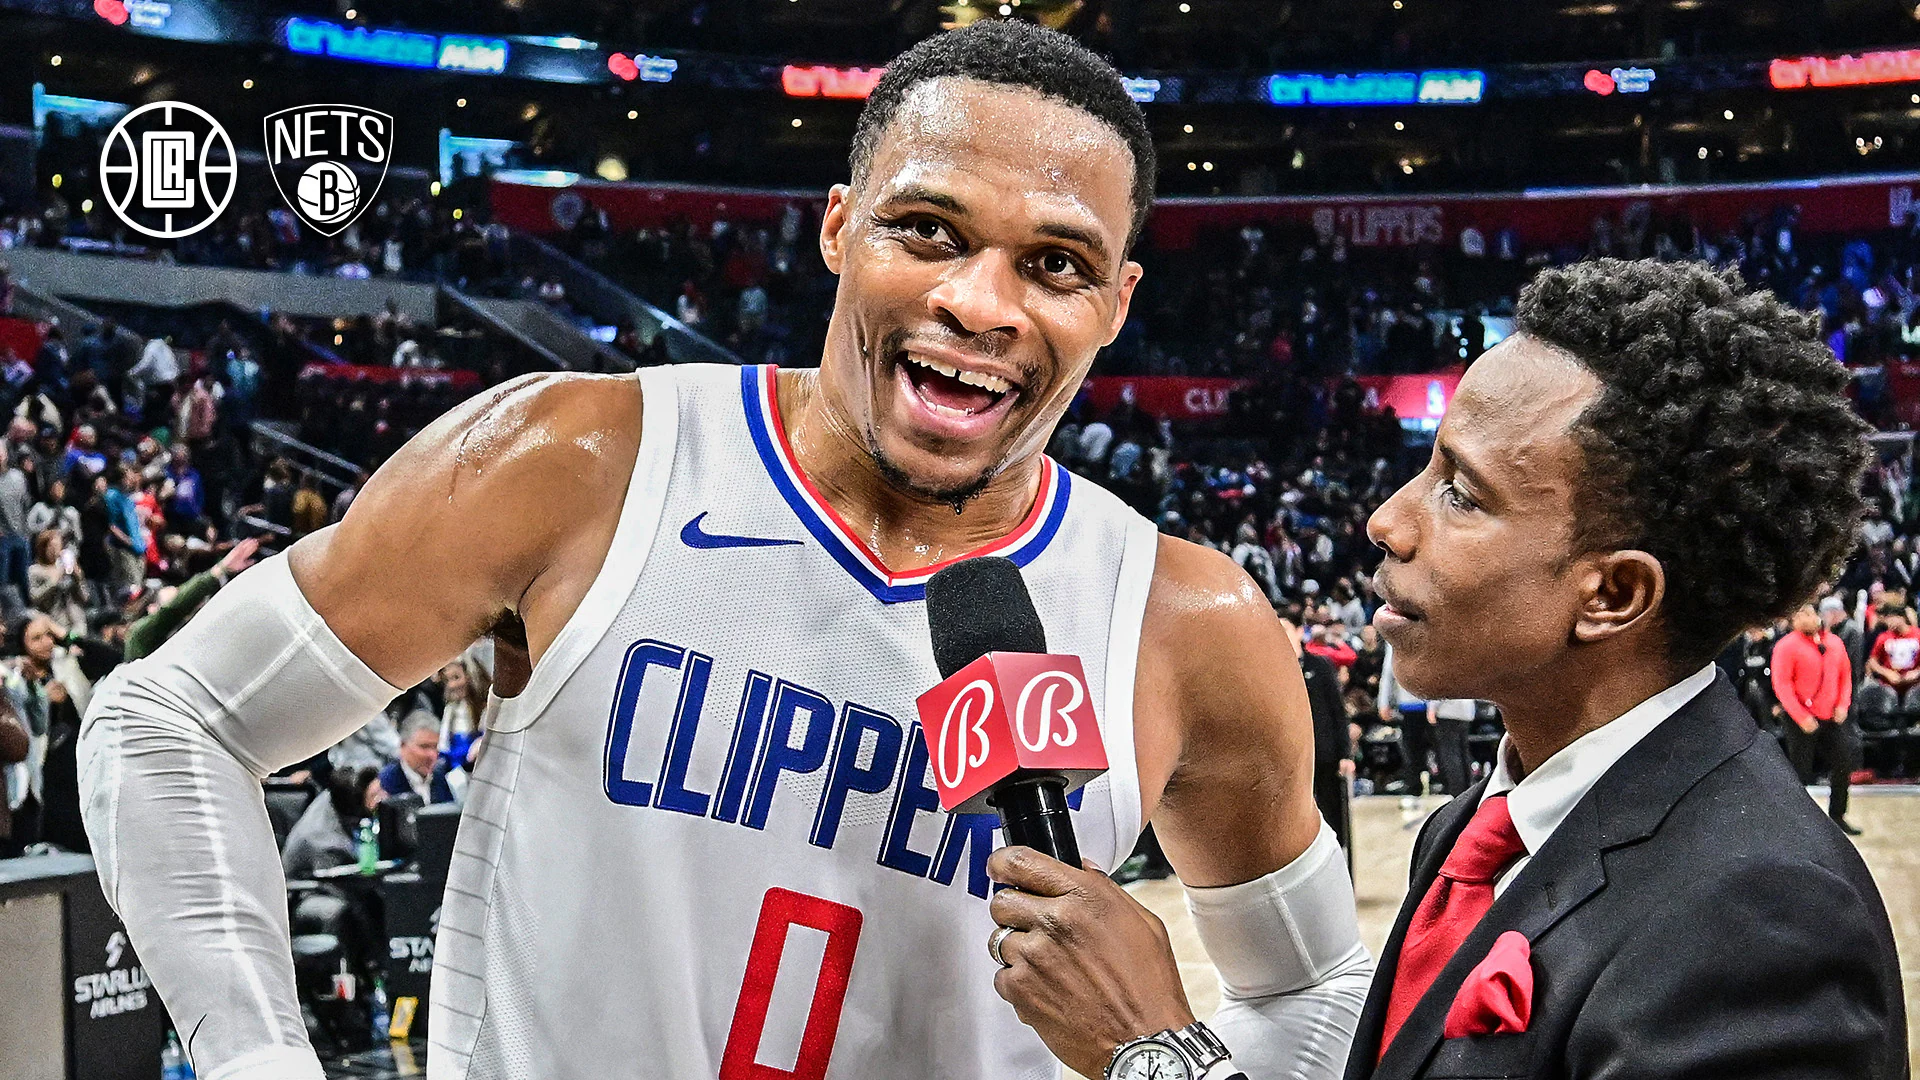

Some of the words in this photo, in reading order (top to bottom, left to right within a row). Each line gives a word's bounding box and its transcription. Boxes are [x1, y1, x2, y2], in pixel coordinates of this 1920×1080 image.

[937, 679, 995, 789] B
[1015, 670, 1084, 752] B
[602, 638, 1085, 900] CLIPPER
[74, 965, 151, 1004] STARLU
[718, 886, 864, 1080] 0
